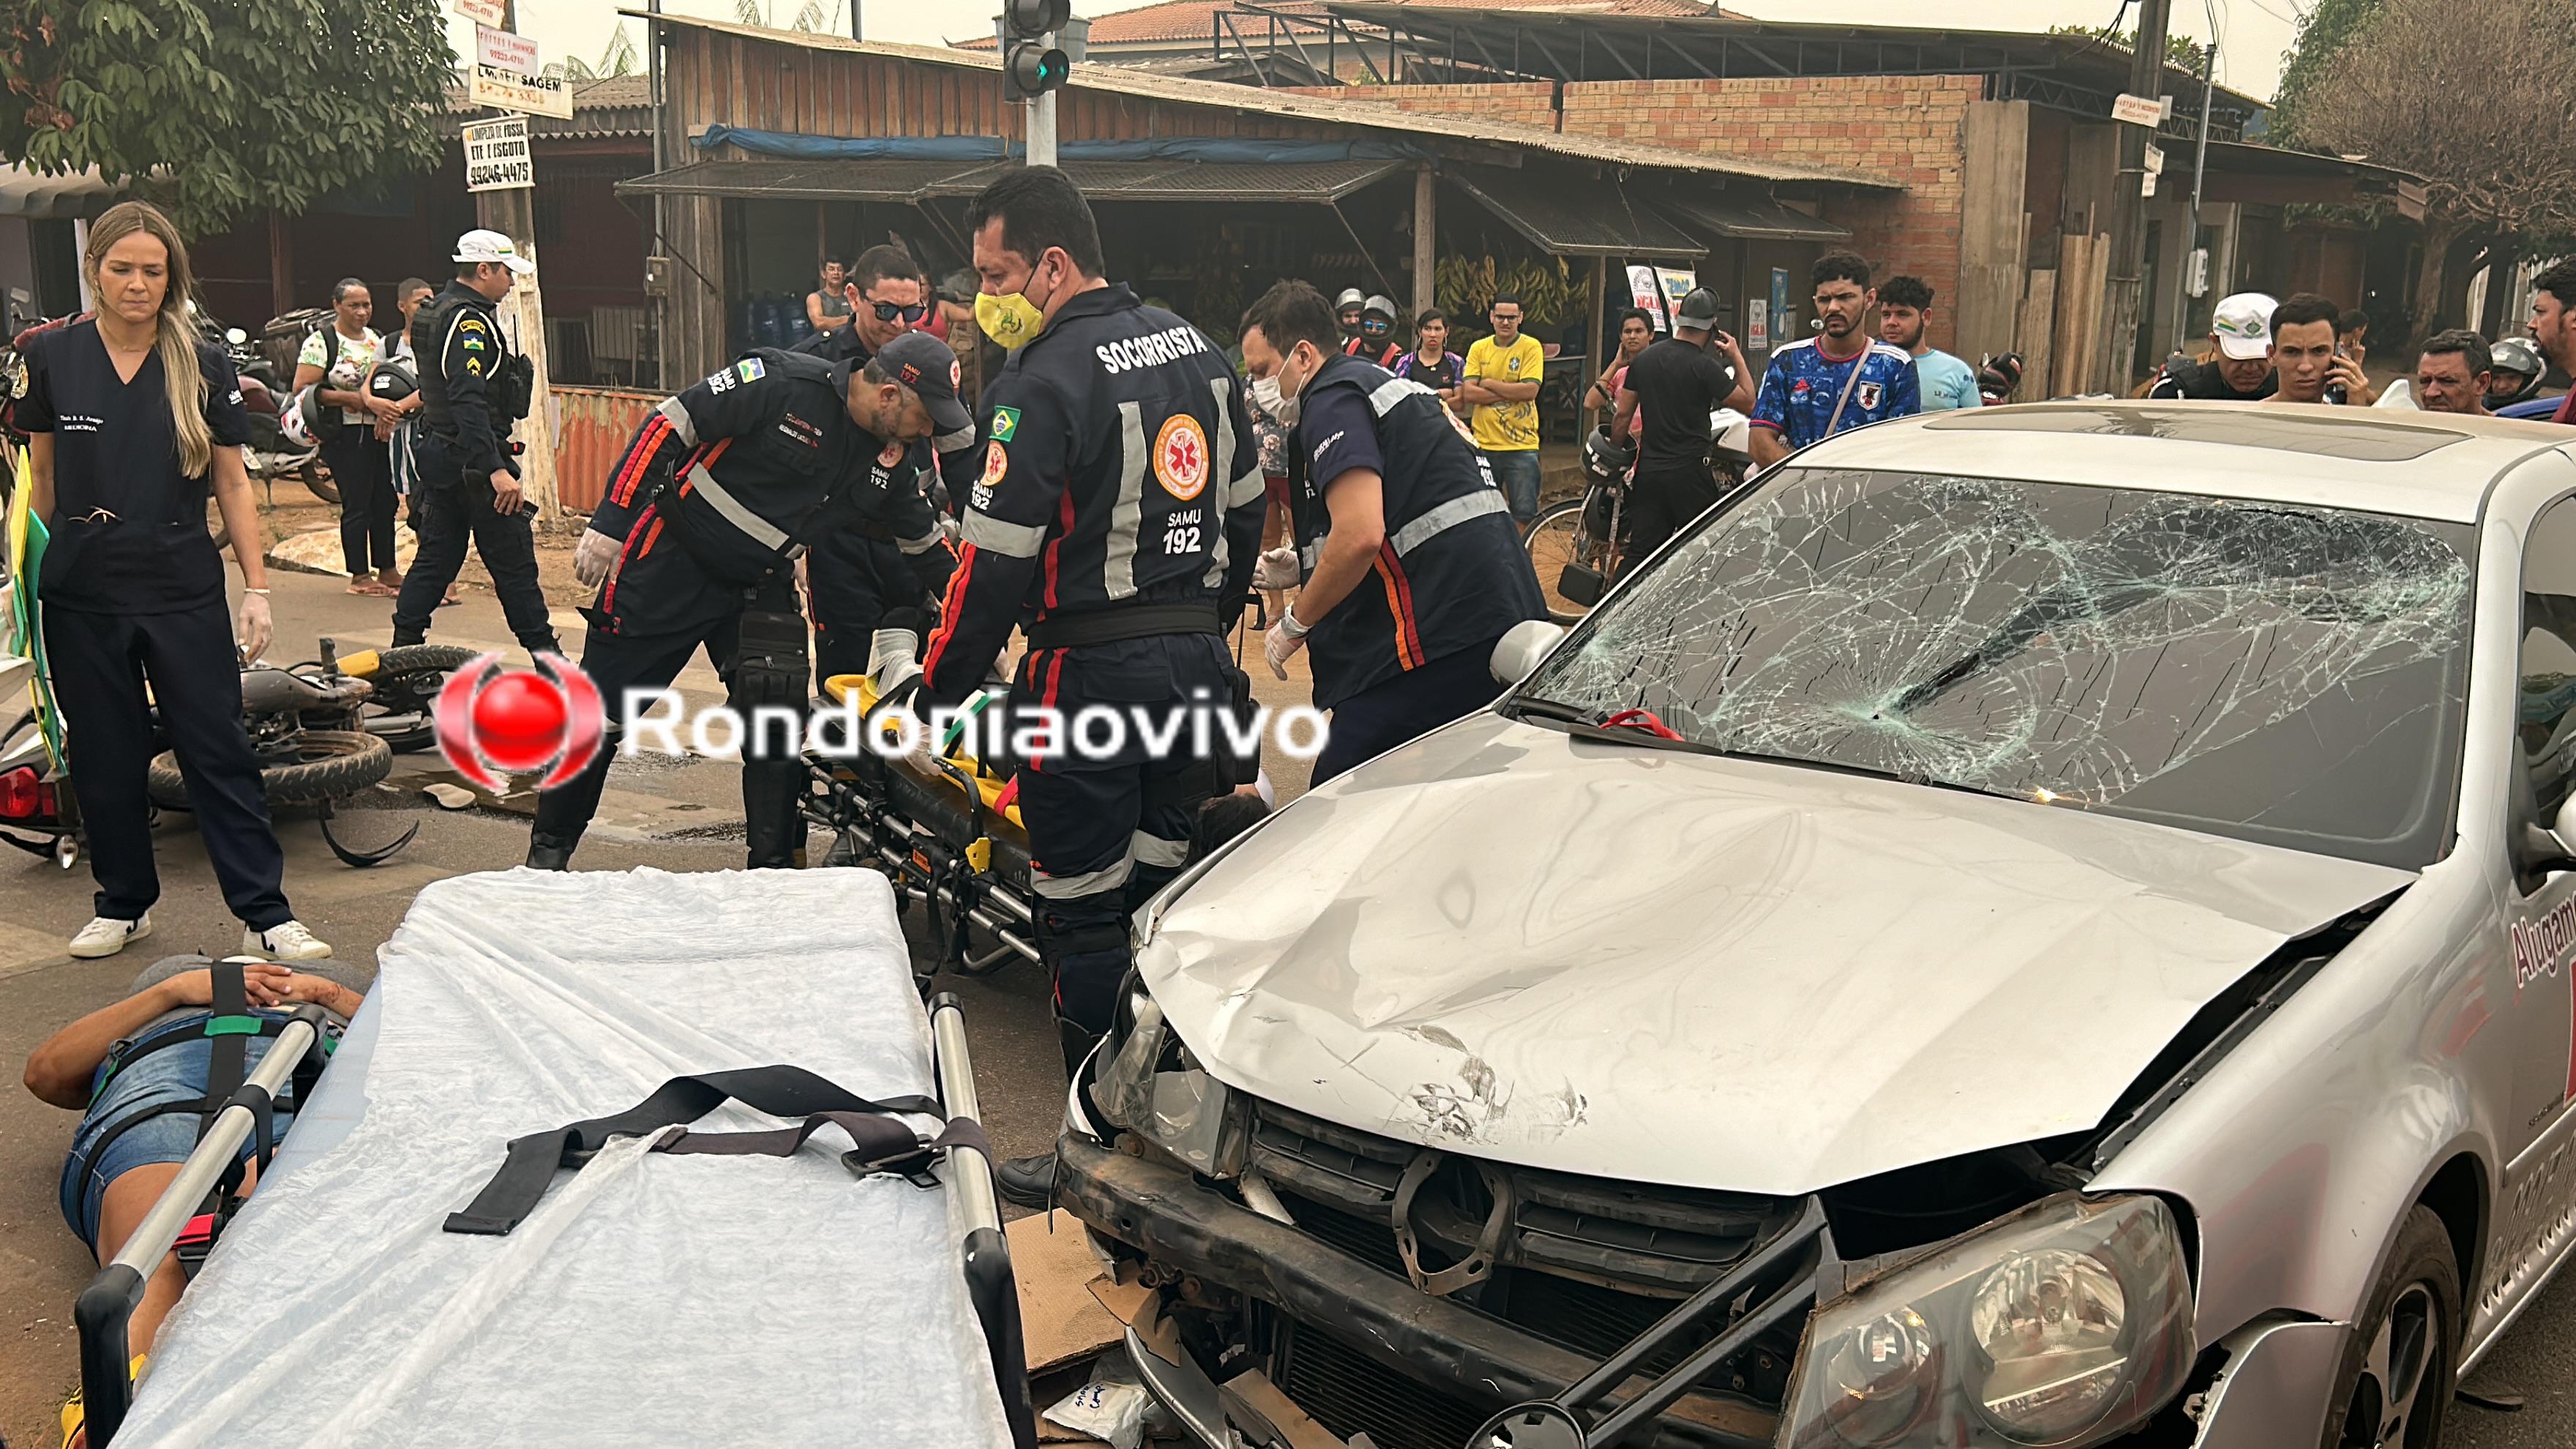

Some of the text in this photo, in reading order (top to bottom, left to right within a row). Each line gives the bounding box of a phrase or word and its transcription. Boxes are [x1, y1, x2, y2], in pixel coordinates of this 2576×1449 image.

[472, 126, 494, 141] LIMPEZA
[495, 125, 503, 138] DE
[493, 141, 525, 158] ESGOTO
[471, 162, 528, 185] 99246-4475
[1096, 326, 1208, 374] SOCORRISTA
[707, 372, 726, 395] 192
[871, 465, 891, 479] SAMU
[869, 474, 888, 490] 192
[971, 490, 990, 510] 192
[1168, 509, 1202, 527] SAMU
[1163, 527, 1201, 555] 192
